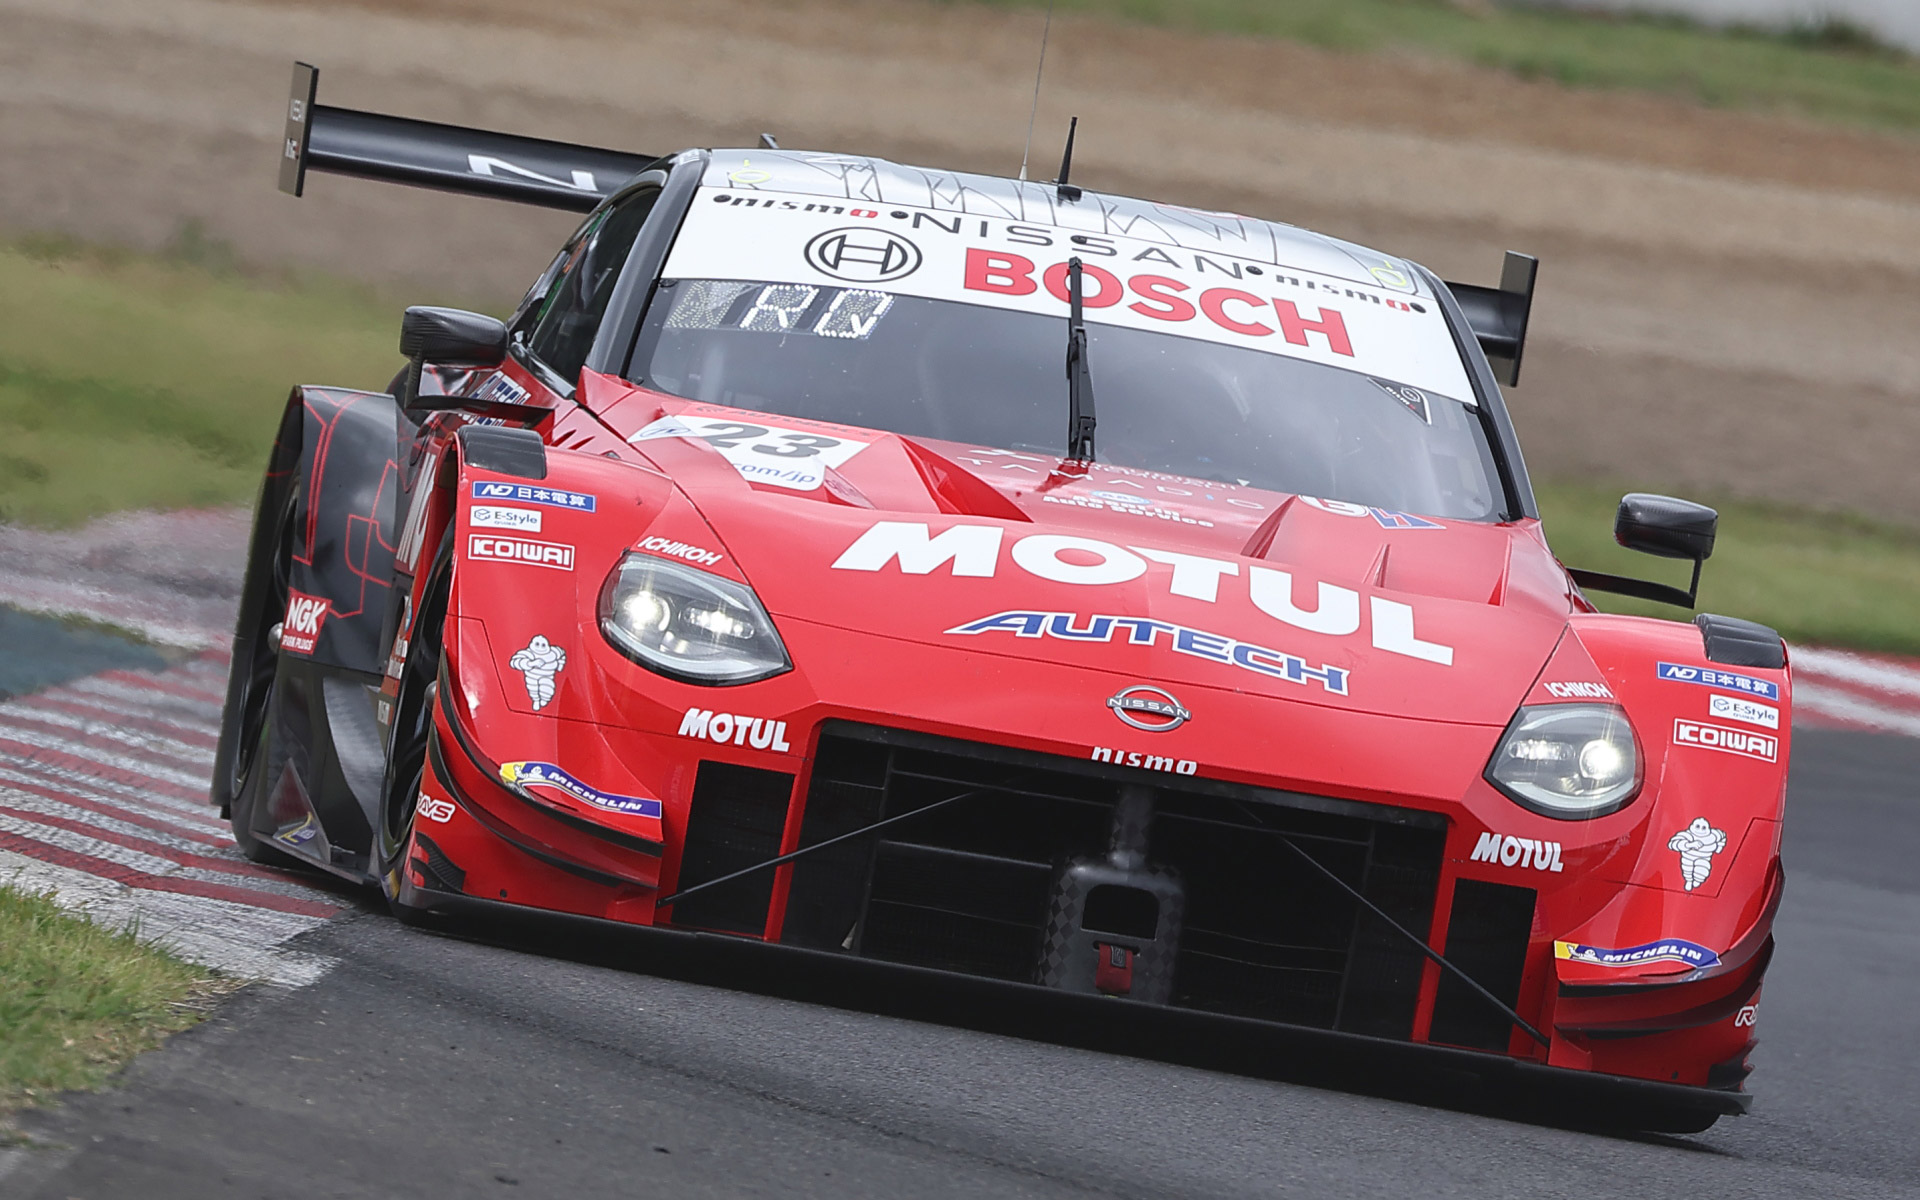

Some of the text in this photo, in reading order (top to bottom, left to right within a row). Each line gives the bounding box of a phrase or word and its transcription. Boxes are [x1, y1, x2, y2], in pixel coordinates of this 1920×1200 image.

[730, 197, 879, 219] nismo
[912, 211, 1243, 281] NISSAN
[963, 247, 1356, 358] BOSCH
[1275, 273, 1411, 312] nismo
[701, 422, 841, 458] 23
[517, 487, 586, 507] 日本電算
[1043, 495, 1103, 510] Auto
[494, 511, 538, 525] E-Style
[473, 538, 570, 566] KOIWAI
[637, 535, 723, 567] ICHIKOH
[831, 521, 1454, 667] MOTUL
[285, 597, 326, 636] NGK
[943, 609, 1350, 697] AUTECH
[1543, 681, 1613, 700] ICHIKOH
[1702, 671, 1769, 694] 日本電算
[1109, 698, 1189, 718] NISSAN
[1733, 703, 1775, 720] E-Style
[678, 707, 790, 753] MOTUL
[1678, 724, 1774, 757] KOIWAI
[1091, 746, 1197, 776] nismo
[417, 791, 455, 823] AYS
[548, 772, 642, 811] MICHELIN
[1470, 832, 1564, 872] MOTUL
[1603, 945, 1702, 962] MICHELIN
